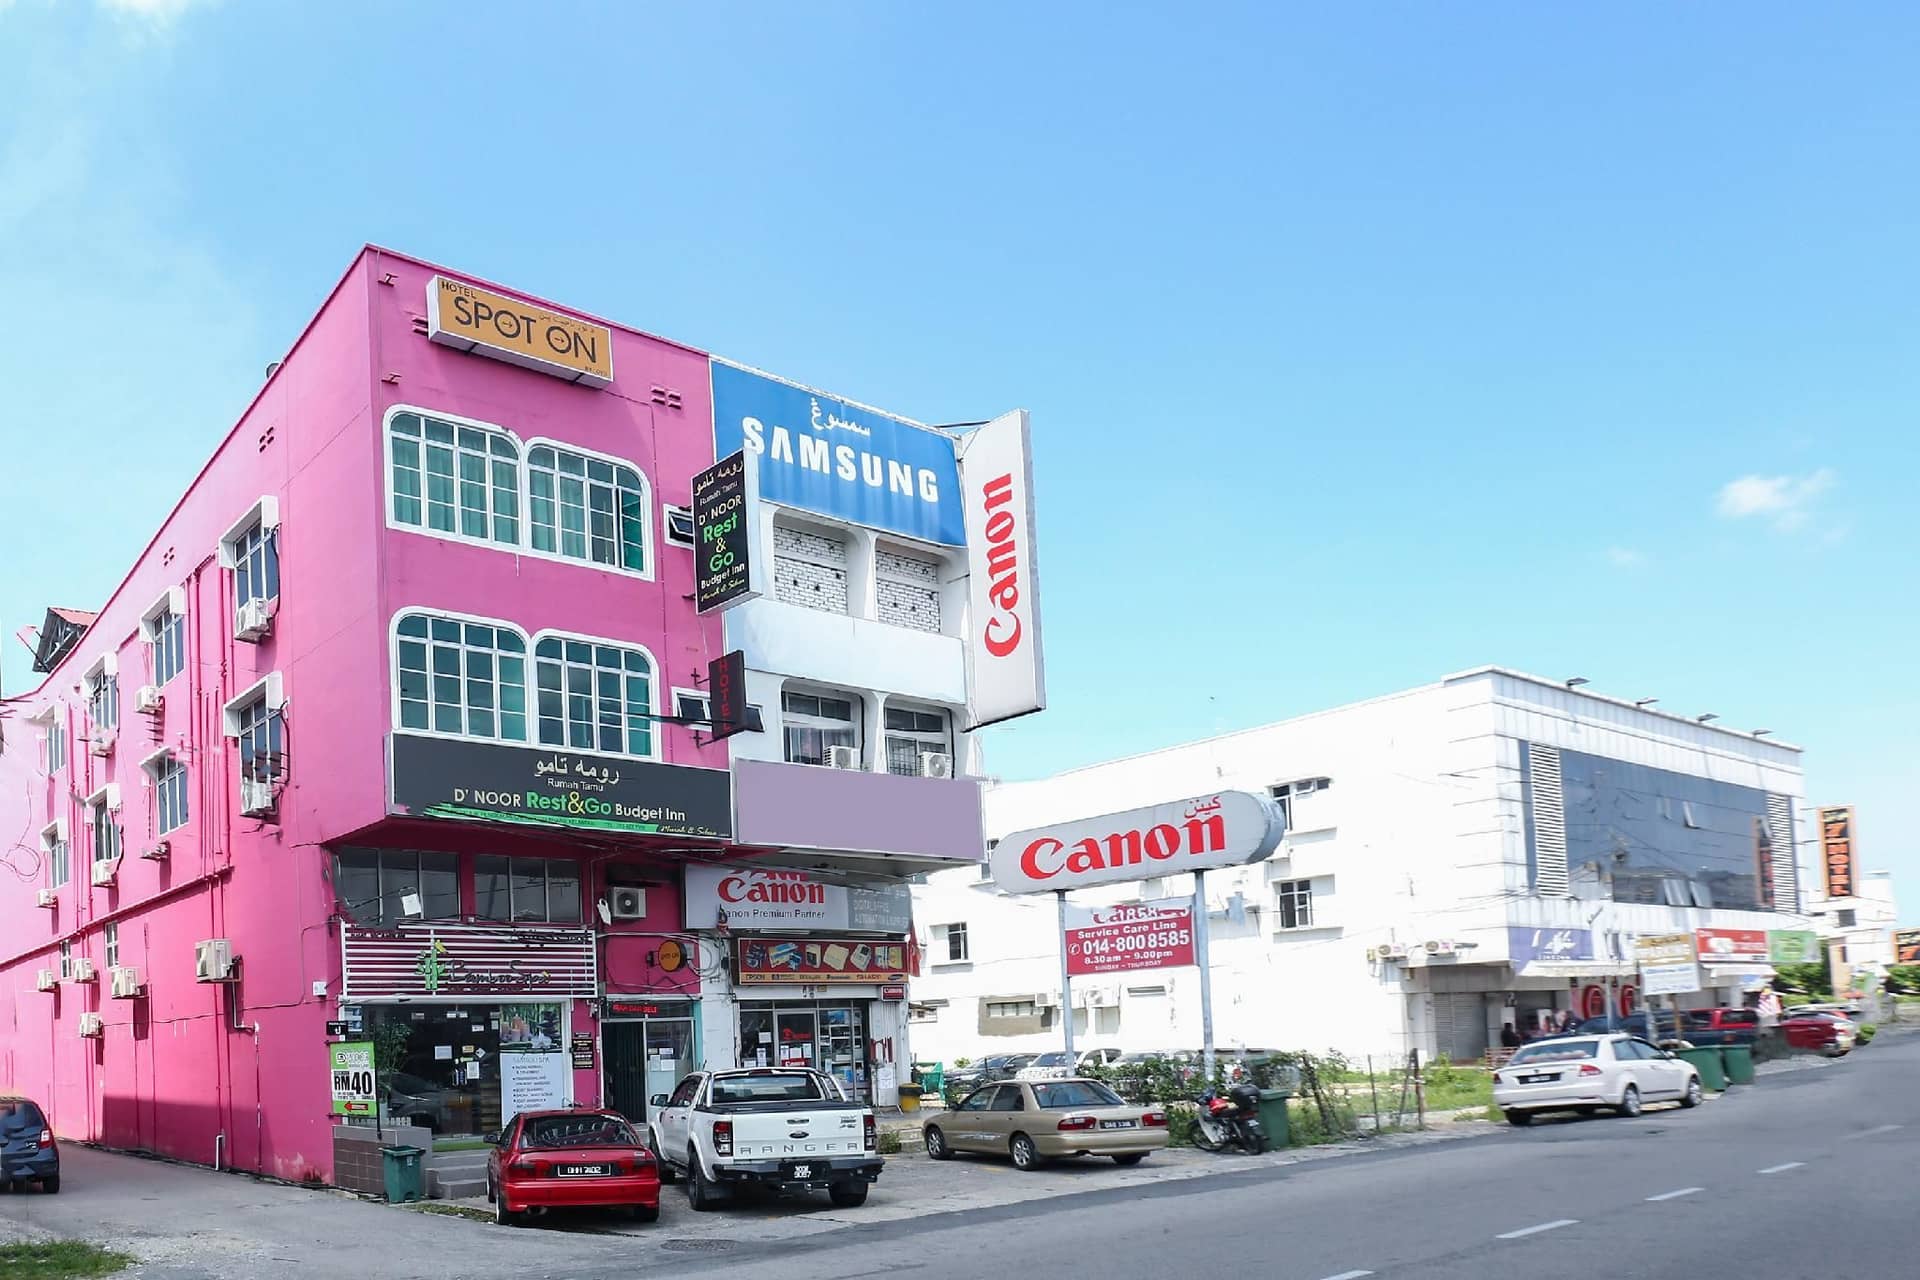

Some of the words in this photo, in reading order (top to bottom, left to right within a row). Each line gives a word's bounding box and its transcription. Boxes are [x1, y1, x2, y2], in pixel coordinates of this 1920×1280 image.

[441, 281, 477, 299] HOTEL
[454, 296, 537, 344] SPOT
[546, 325, 597, 364] ON
[742, 416, 938, 502] SAMSUNG
[711, 494, 742, 520] NOOR
[703, 511, 738, 544] Rest
[715, 536, 727, 553] &
[701, 567, 730, 590] Budget
[732, 562, 745, 576] Inn
[984, 473, 1021, 658] Canon
[548, 778, 579, 790] Rumah
[580, 781, 604, 792] Tamu
[474, 788, 521, 808] NOOR
[615, 803, 662, 821] Budget
[665, 806, 686, 821] Inn
[1020, 814, 1226, 880] Canon
[717, 876, 825, 904] Canon
[724, 909, 749, 918] anon
[753, 909, 792, 918] Premium
[794, 909, 825, 918] Partner
[1078, 929, 1119, 940] Service
[1123, 924, 1149, 934] Care
[1153, 921, 1177, 930] Line
[1084, 955, 1121, 965] 8.30am
[1134, 950, 1173, 961] 9.00pm
[334, 1075, 350, 1090] RM
[351, 1071, 372, 1095] 40
[740, 1142, 858, 1155] RANGER
